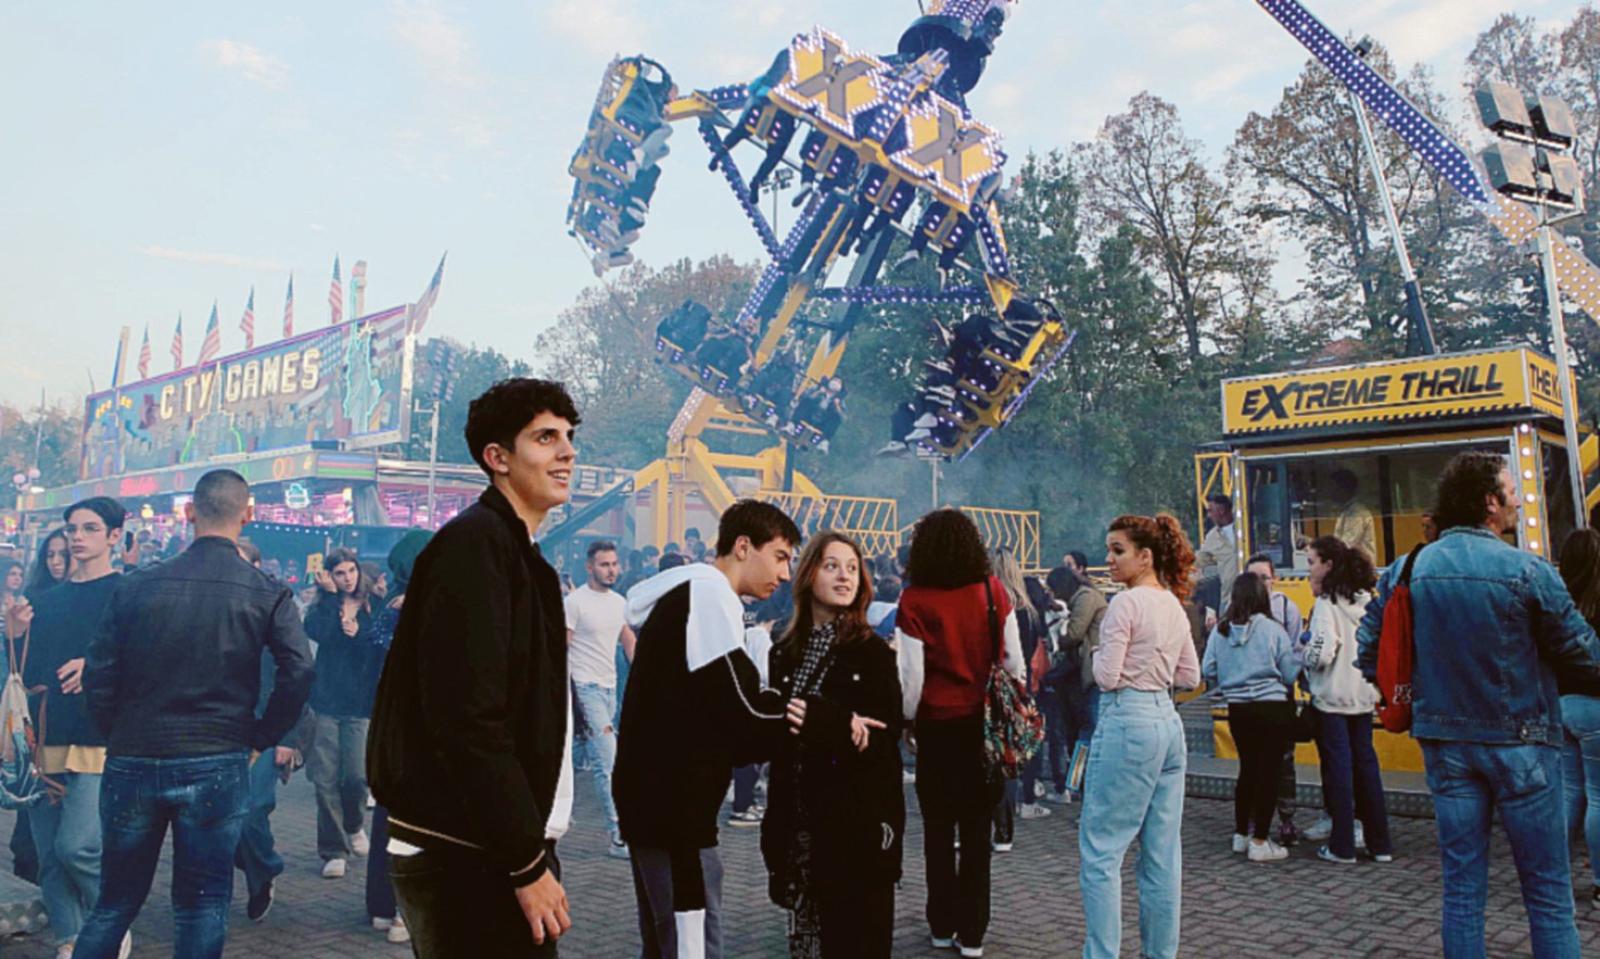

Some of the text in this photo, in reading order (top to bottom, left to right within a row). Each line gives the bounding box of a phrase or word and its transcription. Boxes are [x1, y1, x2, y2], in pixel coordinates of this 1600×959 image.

[225, 347, 321, 403] GAMES
[1241, 363, 1504, 421] EXTREME THRILL
